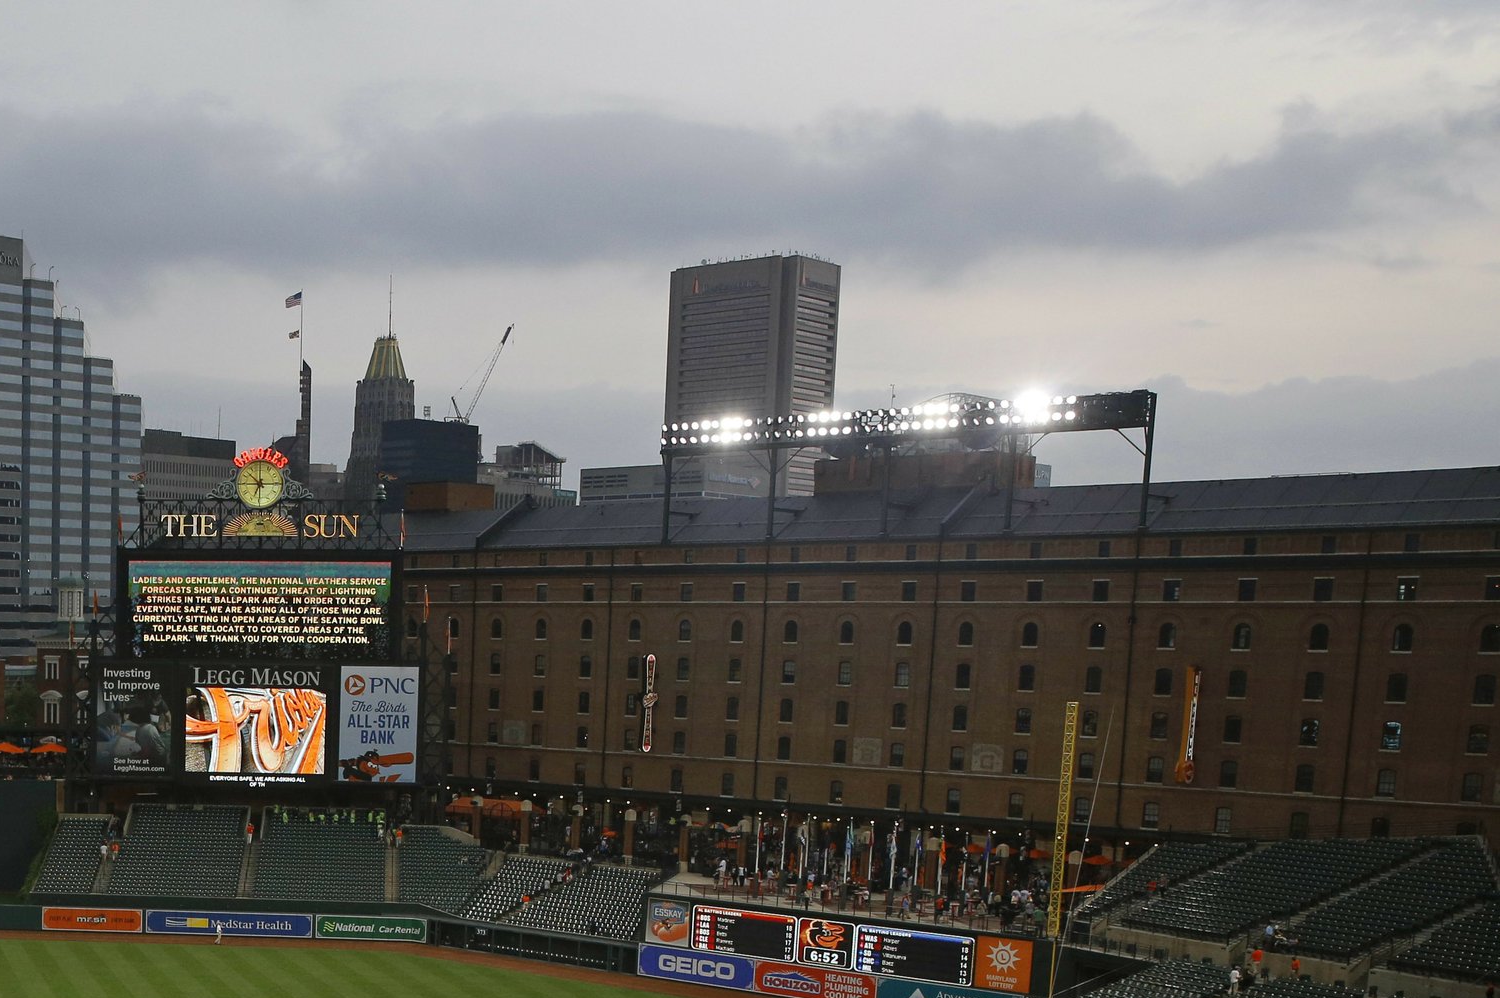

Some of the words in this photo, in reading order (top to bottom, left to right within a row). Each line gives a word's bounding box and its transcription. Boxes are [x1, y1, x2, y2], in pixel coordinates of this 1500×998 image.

[233, 446, 289, 469] ORIOLES
[161, 514, 218, 537] THE
[303, 514, 360, 538] SUN
[103, 668, 151, 679] Investing
[192, 667, 245, 684] LEGG
[250, 667, 321, 686] MASON
[103, 680, 114, 690] to
[118, 680, 160, 691] Improve
[370, 677, 416, 694] PNC
[103, 692, 130, 702] Lives
[351, 700, 372, 712] The
[374, 700, 407, 713] Birds
[347, 714, 410, 729] ALL-STAR
[360, 730, 395, 744] BANK
[654, 908, 682, 918] ESSKAY
[211, 920, 254, 929] MedStar
[256, 920, 292, 931] Health
[335, 922, 374, 933] National
[395, 926, 420, 935] Rental
[865, 935, 878, 943] WAS
[810, 951, 839, 965] 6:52
[658, 954, 735, 980] GEICO
[763, 976, 821, 994] HORIZON
[824, 974, 863, 986] HEATING
[986, 974, 1017, 983] MARYLAND
[824, 984, 869, 996] PLUMBING
[988, 981, 1014, 990] LOTTERY
